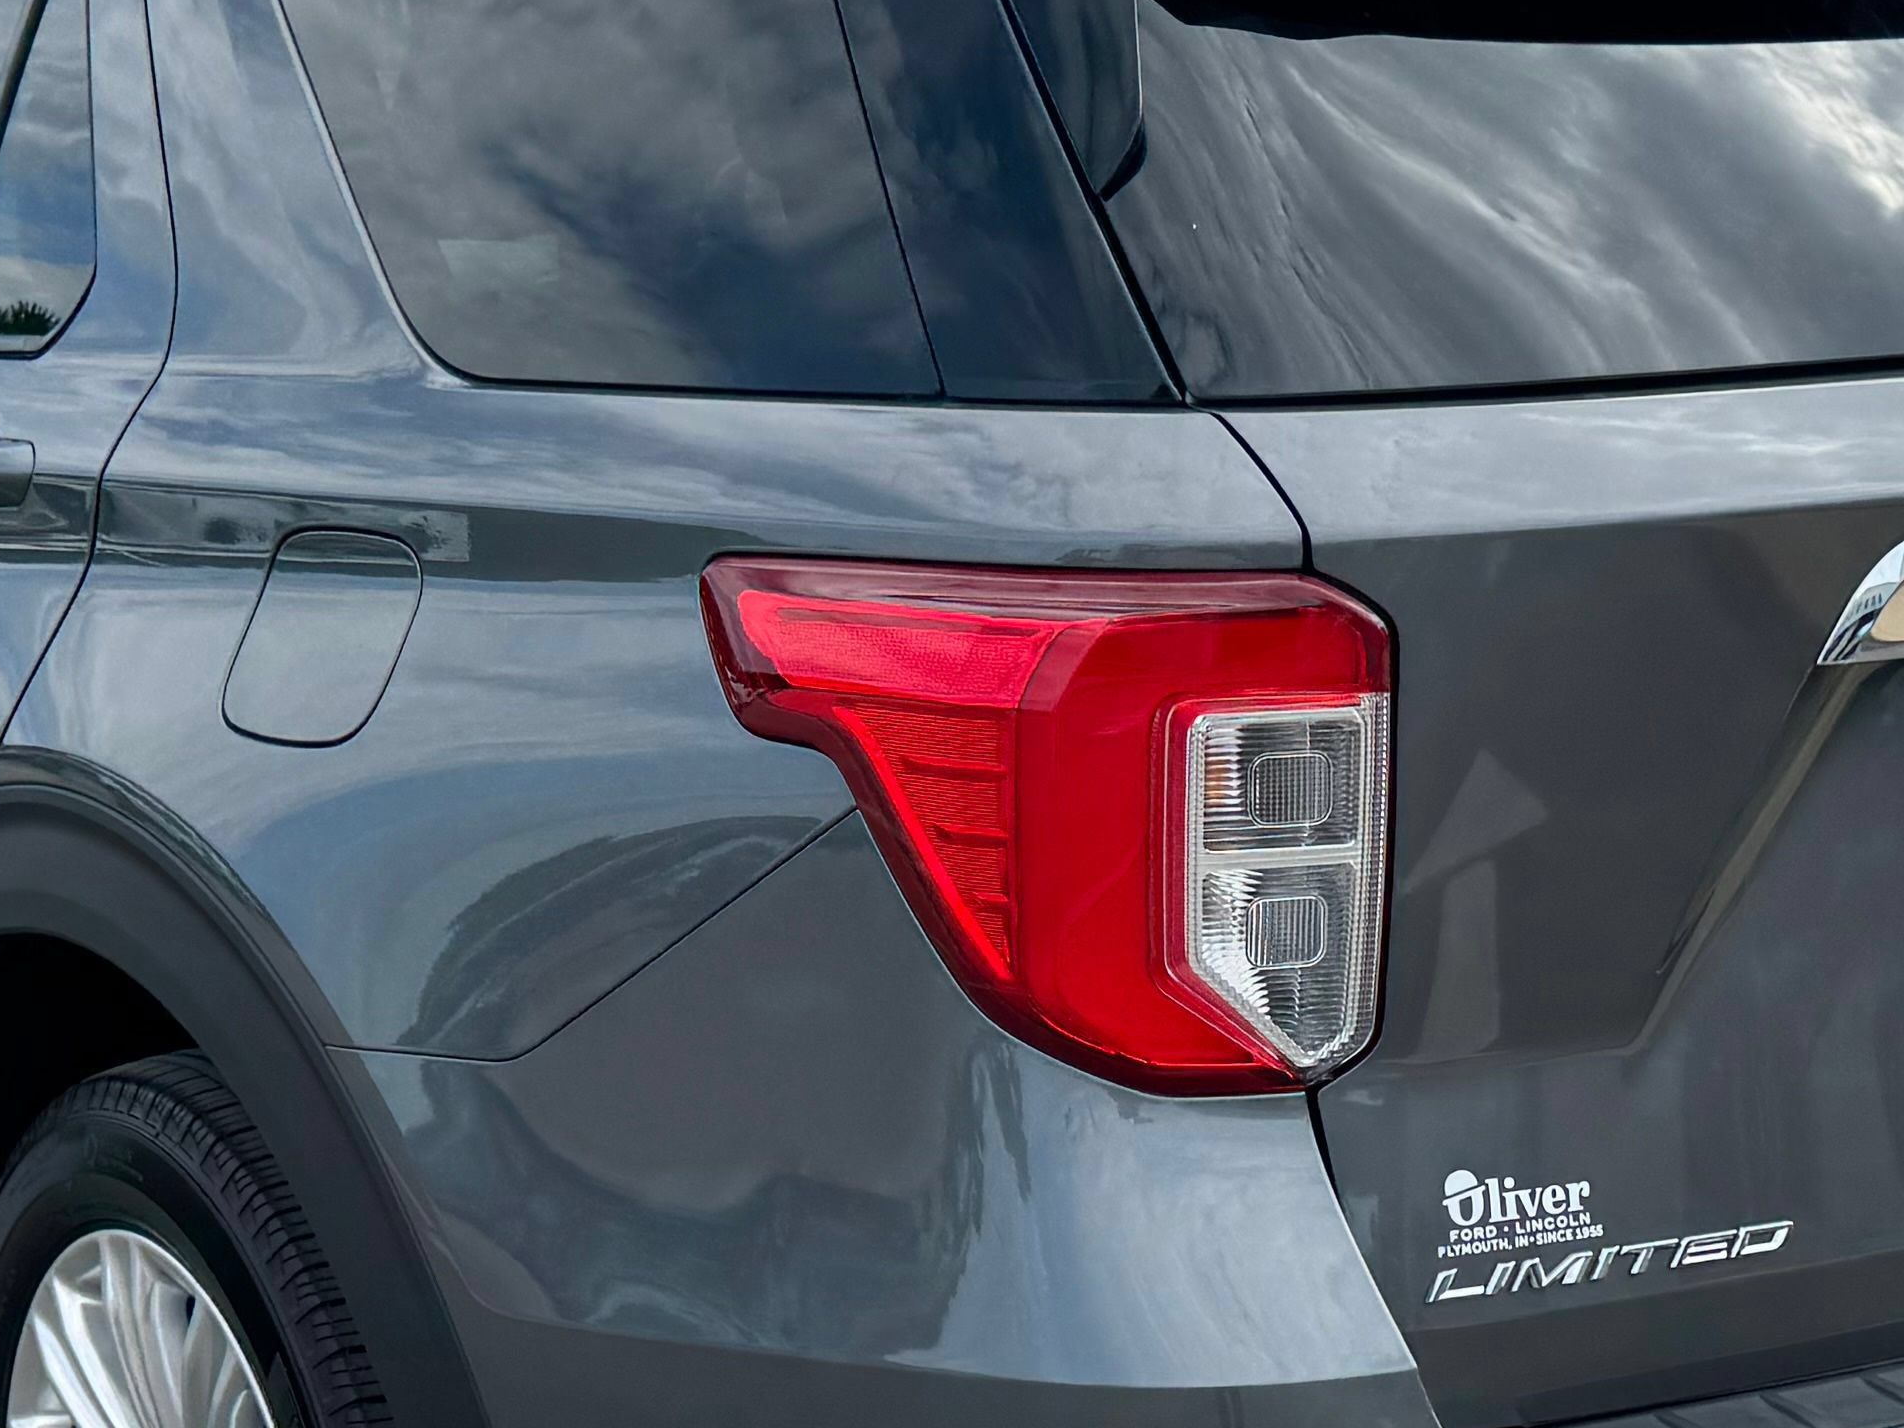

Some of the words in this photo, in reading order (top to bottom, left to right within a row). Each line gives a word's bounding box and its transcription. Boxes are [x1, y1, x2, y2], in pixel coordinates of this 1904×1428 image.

[1442, 1169, 1591, 1227] Oliver
[1437, 1237, 1513, 1259] PLYMOUTH,
[1449, 1224, 1497, 1243] FORD
[1515, 1212, 1591, 1235] LINCOLN
[1424, 1220, 1794, 1303] LIMITED
